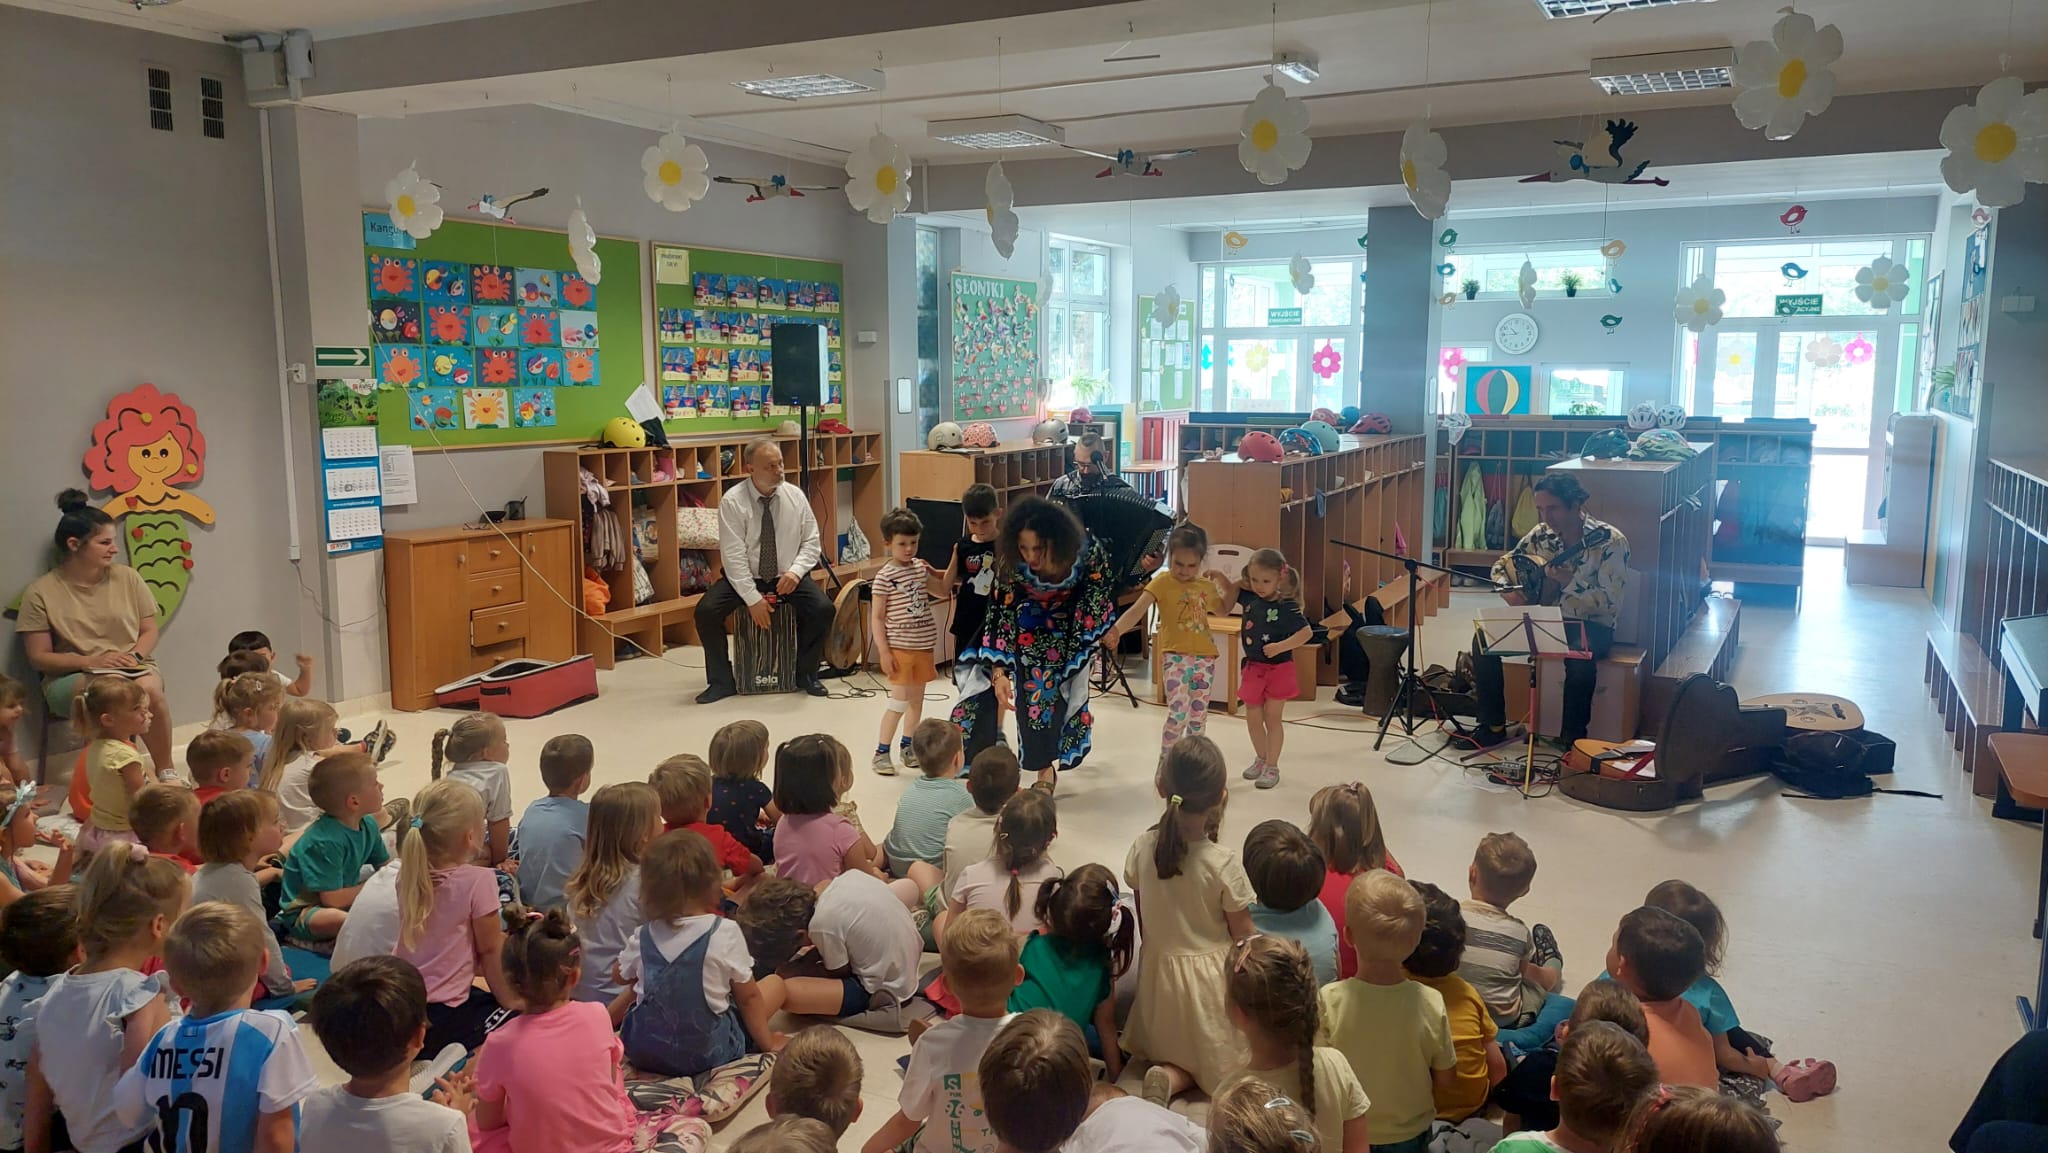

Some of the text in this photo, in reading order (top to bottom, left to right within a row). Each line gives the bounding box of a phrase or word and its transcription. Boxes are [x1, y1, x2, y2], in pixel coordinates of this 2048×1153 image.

[955, 278, 1004, 298] SŁONIKI
[756, 675, 778, 684] Sela
[151, 1047, 224, 1079] MESSI
